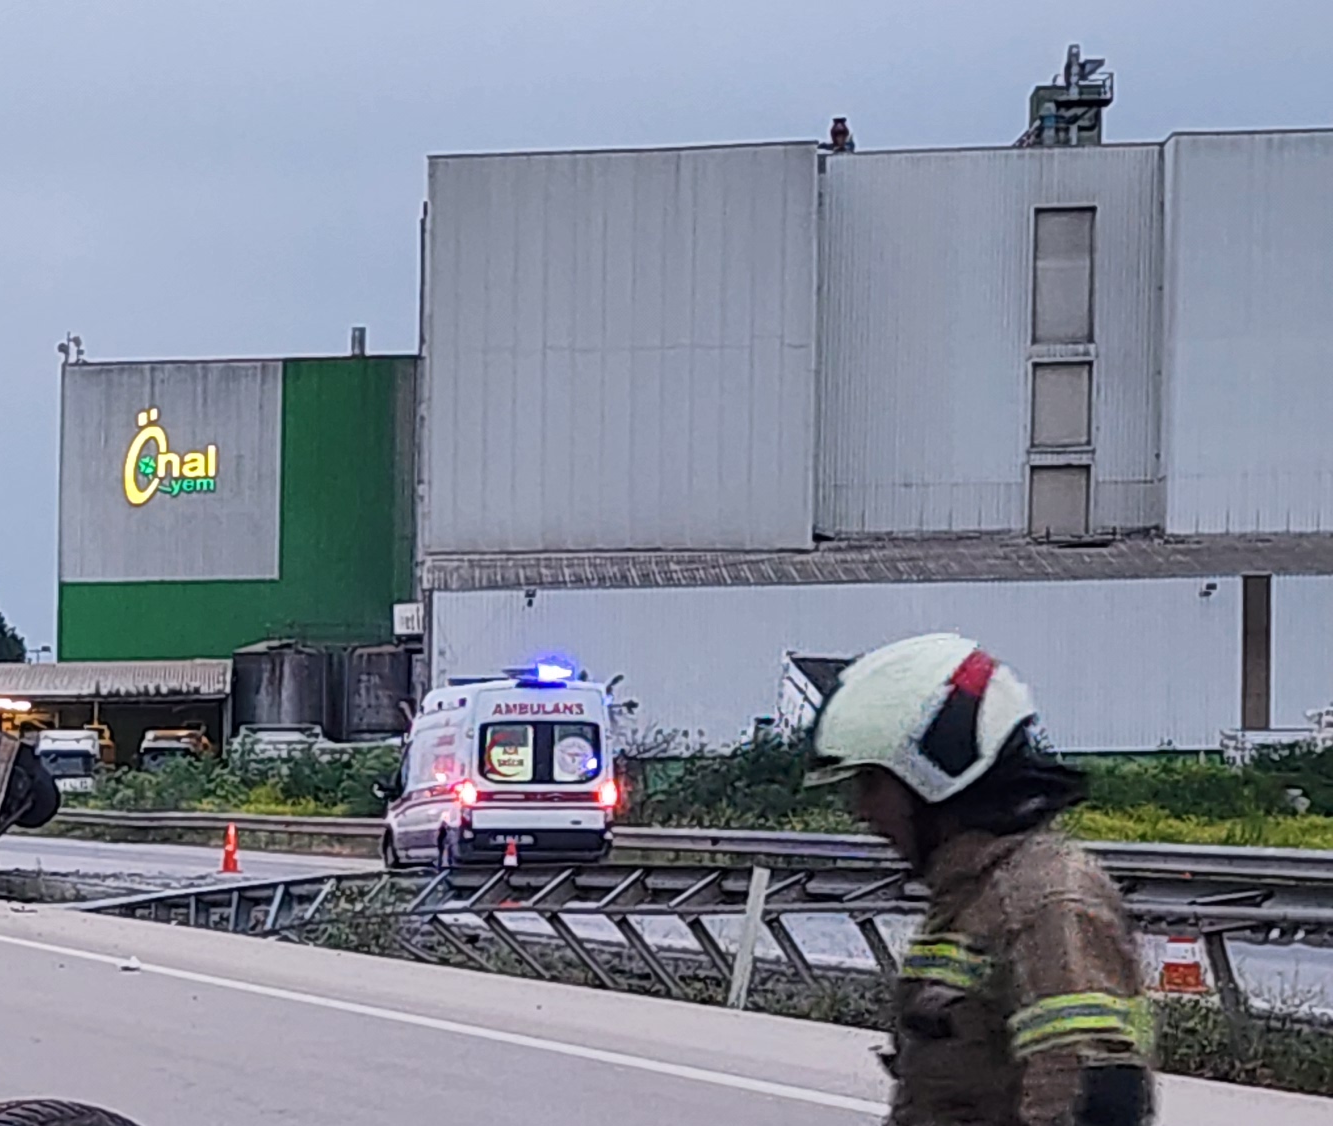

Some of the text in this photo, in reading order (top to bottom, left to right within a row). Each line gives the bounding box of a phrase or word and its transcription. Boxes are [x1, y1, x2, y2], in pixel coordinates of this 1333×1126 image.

[124, 408, 216, 504] Önal
[170, 478, 214, 496] yem
[492, 702, 584, 715] AMBULANS
